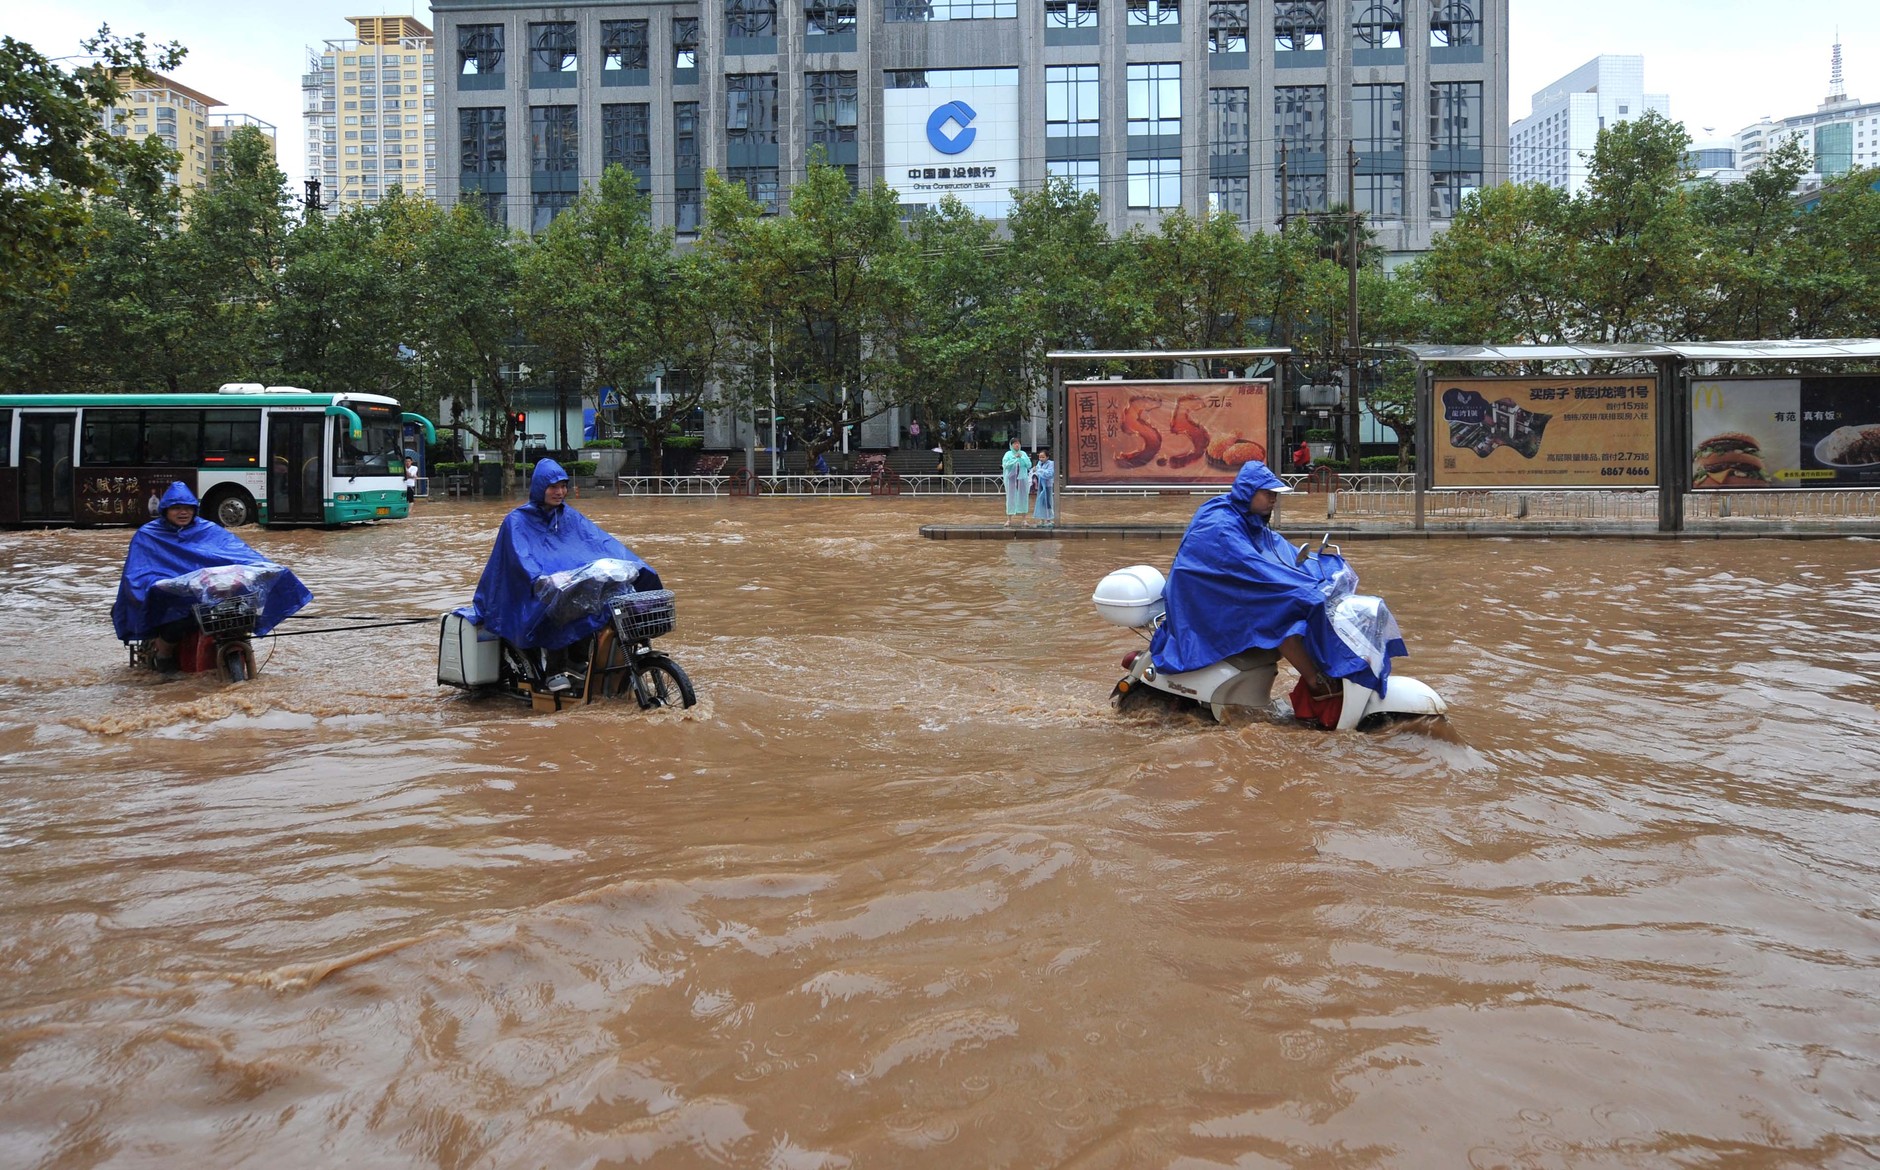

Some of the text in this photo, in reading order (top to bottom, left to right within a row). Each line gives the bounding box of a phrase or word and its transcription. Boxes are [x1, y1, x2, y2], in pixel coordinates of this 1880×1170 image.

[908, 166, 997, 179] 中国建设银行
[932, 182, 972, 190] Construction
[1606, 401, 1649, 411] 首付15万起
[1106, 396, 1119, 438] 火热价
[1775, 411, 1835, 422] 有范 真有饭
[1078, 395, 1100, 468] 香辣鸡翅
[1600, 467, 1624, 476] 6867
[1626, 467, 1650, 476] 4666
